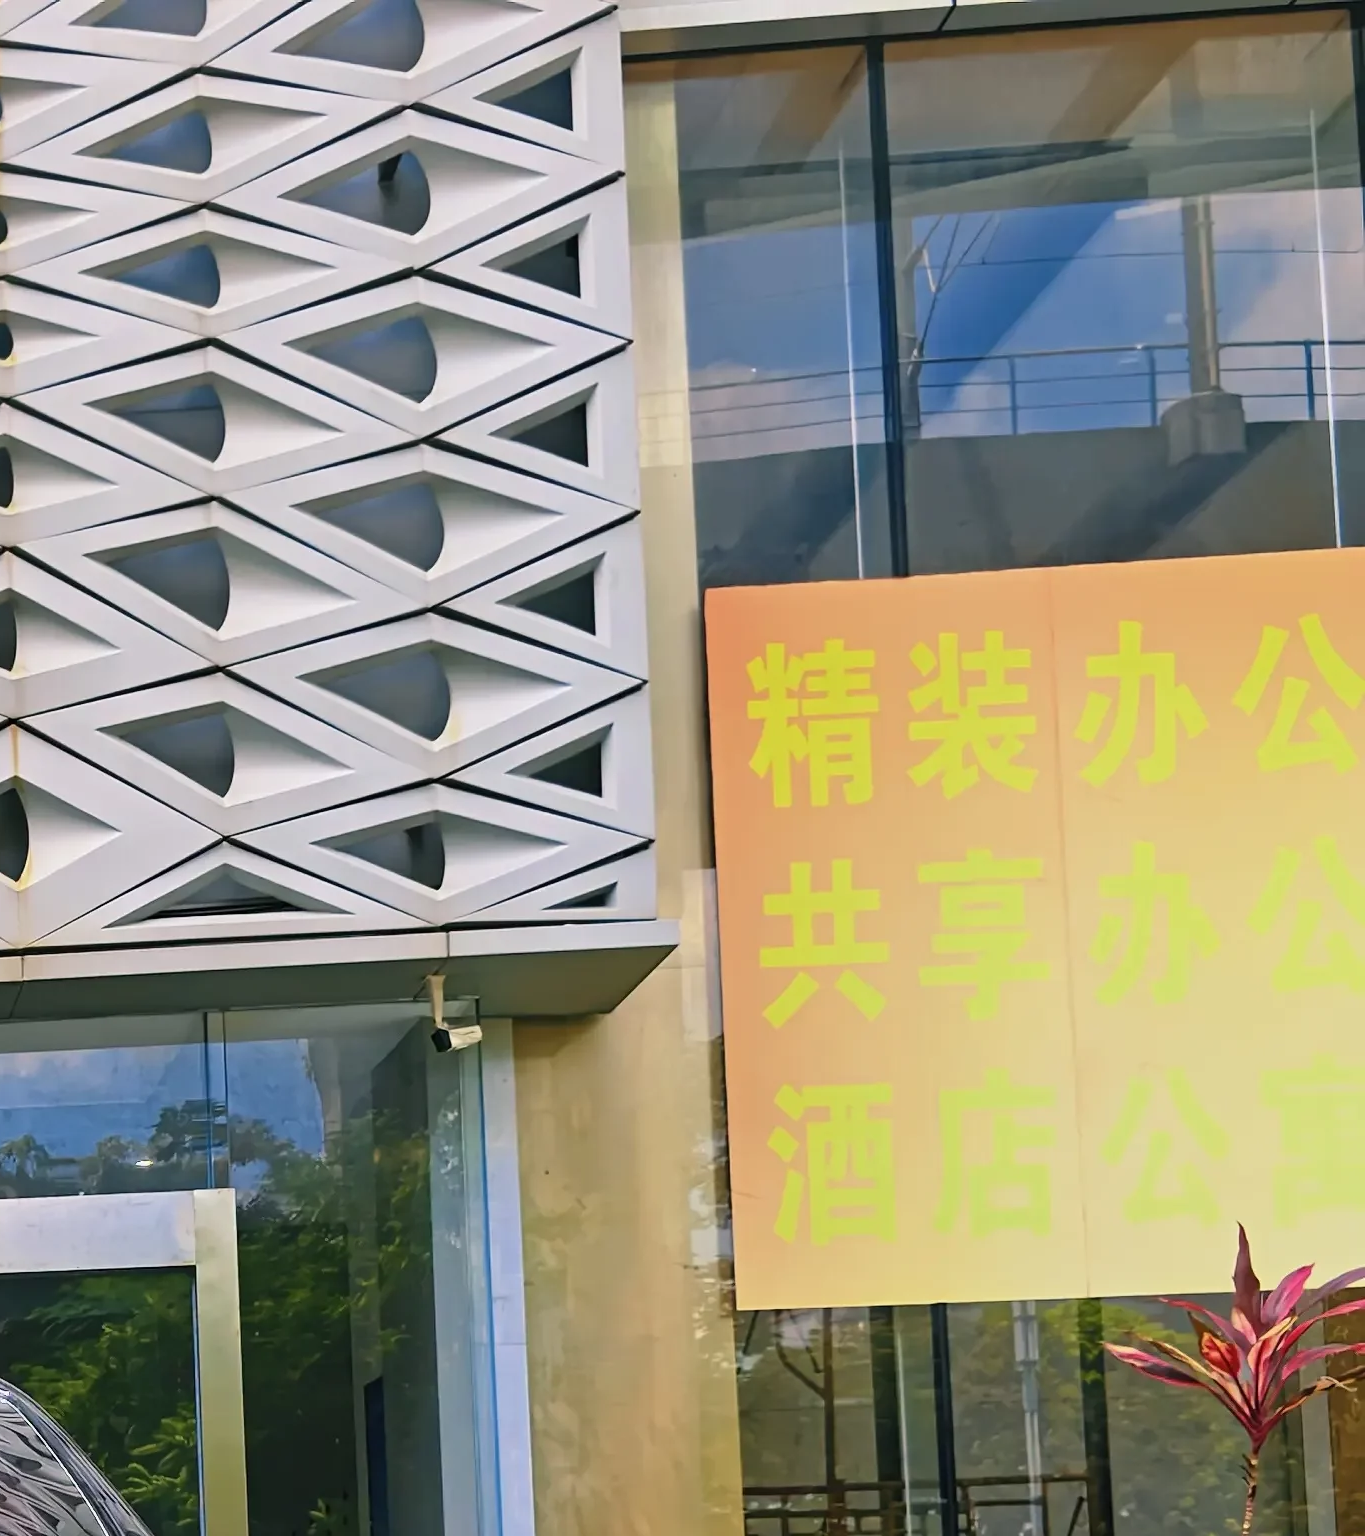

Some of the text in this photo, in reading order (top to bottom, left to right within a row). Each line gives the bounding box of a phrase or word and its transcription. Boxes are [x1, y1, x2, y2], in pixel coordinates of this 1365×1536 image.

[746, 613, 1365, 808] 精装办公
[759, 836, 1365, 1029] 共享办公
